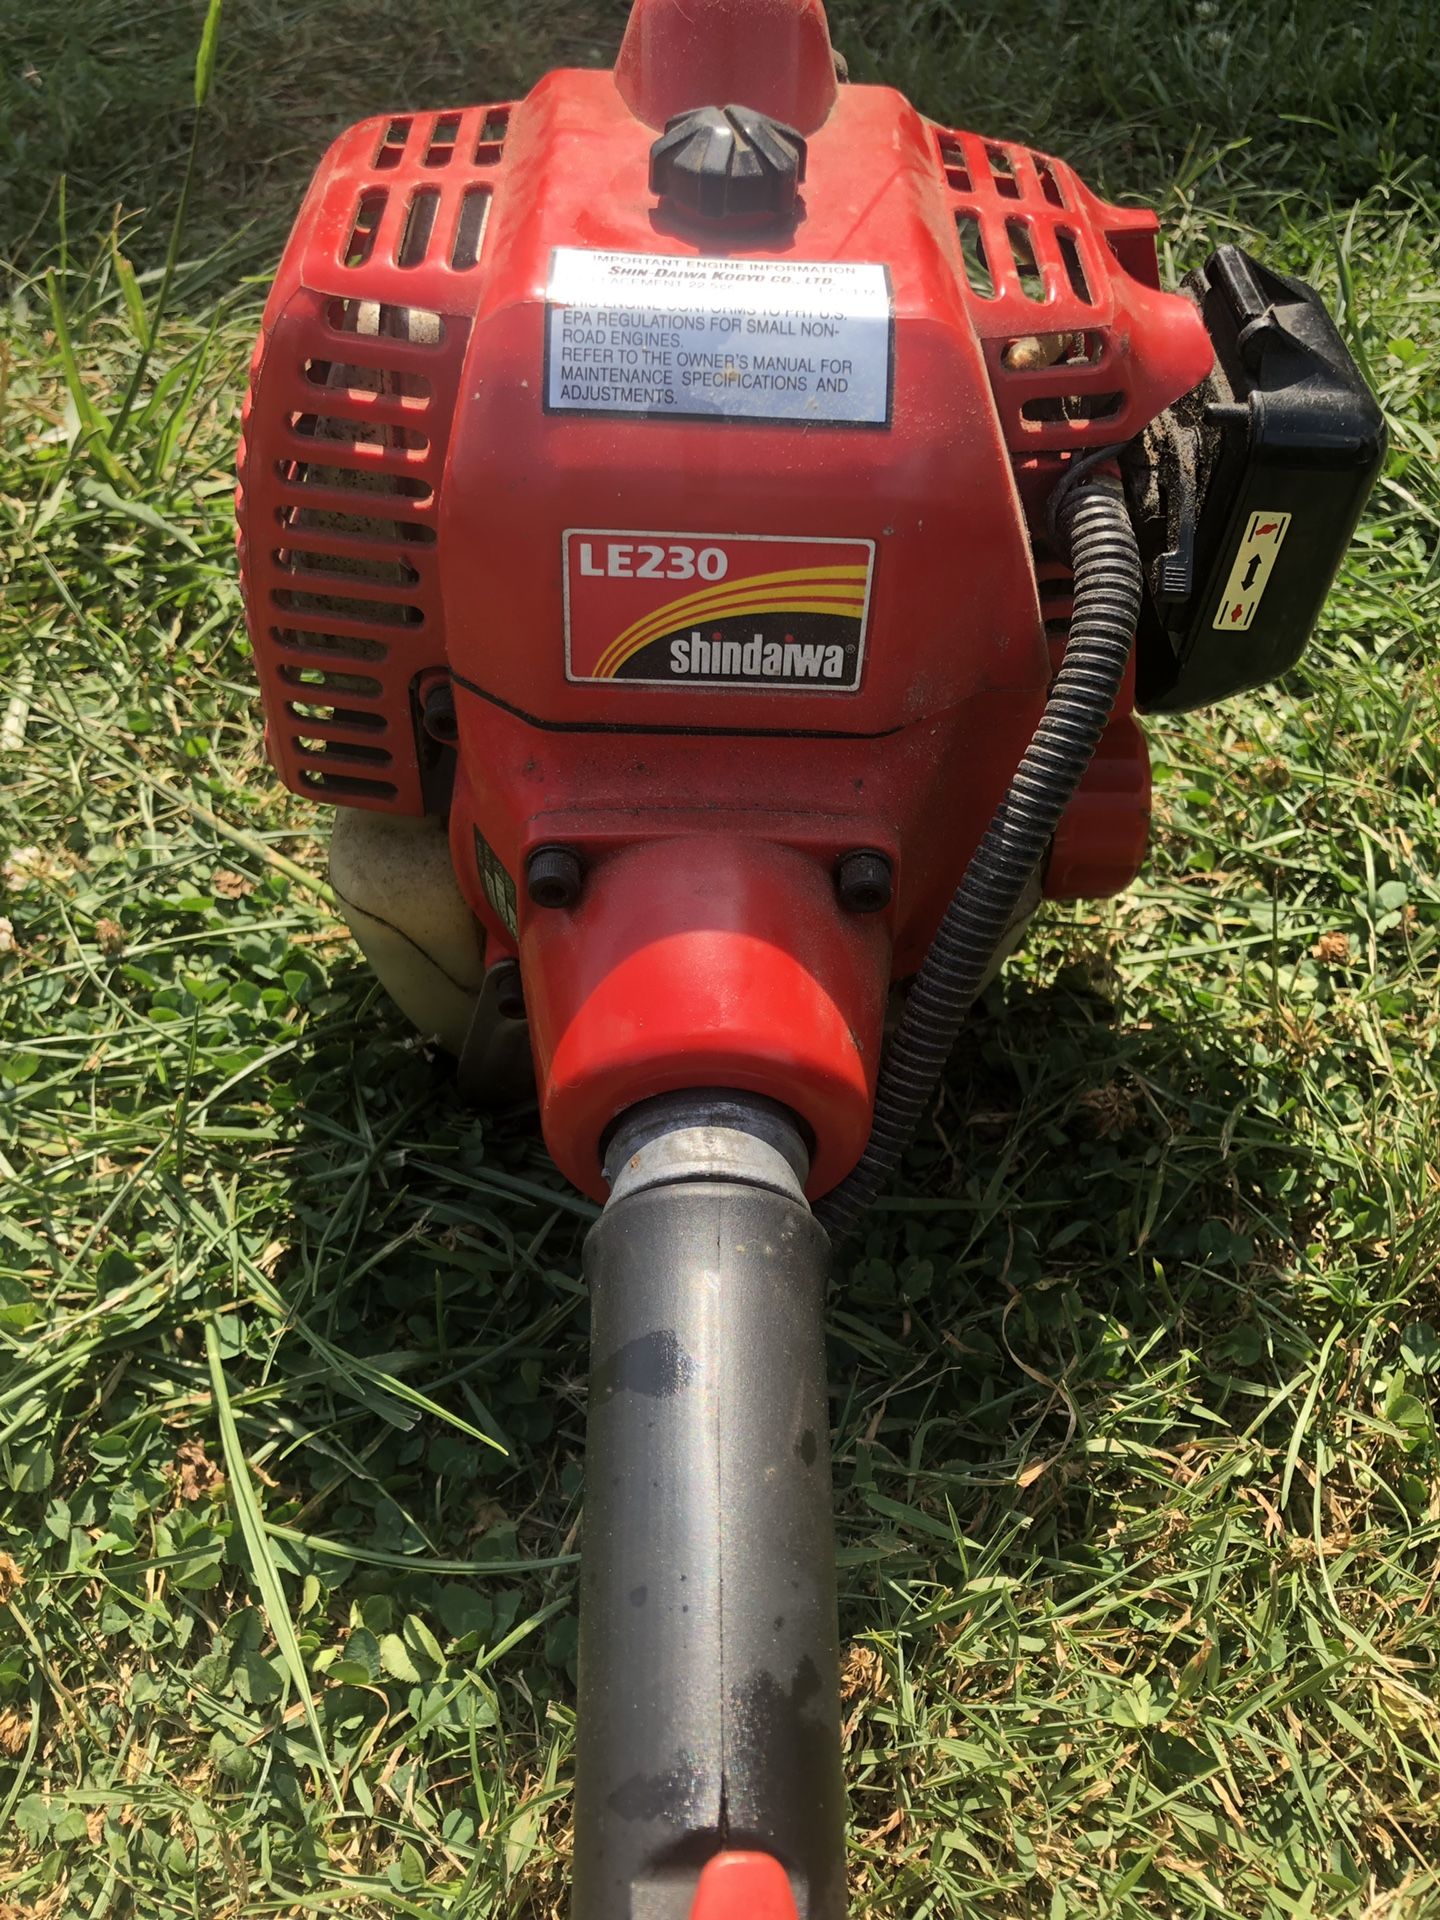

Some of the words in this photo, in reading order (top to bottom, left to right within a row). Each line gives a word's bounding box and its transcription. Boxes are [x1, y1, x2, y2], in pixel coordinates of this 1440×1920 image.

[593, 255, 680, 268] IMPORTANT
[686, 261, 744, 270] ENGINE
[749, 263, 856, 275] INFORMATION
[608, 265, 708, 280] SHIN-DAIWA
[562, 311, 593, 326] EPA
[596, 312, 706, 331] REGULATIONS
[710, 317, 742, 332] FOR
[747, 319, 796, 335] SMALL
[800, 322, 840, 338] NON-
[561, 329, 606, 344] ROAD
[610, 331, 684, 348] ENGINES.
[561, 347, 613, 363] REFER
[618, 350, 639, 364] TO
[642, 350, 672, 366] THE
[677, 352, 749, 369] OWNER'S
[753, 356, 815, 373] MANUAL
[819, 358, 853, 375] FOR
[560, 366, 672, 385] MAINTENANCE
[681, 373, 808, 391] SPECIFICATIONS
[815, 377, 849, 392] AND
[560, 384, 678, 404] ADJUSTMENTS.
[579, 543, 728, 581] LE230
[670, 631, 844, 678] shindaiwa
